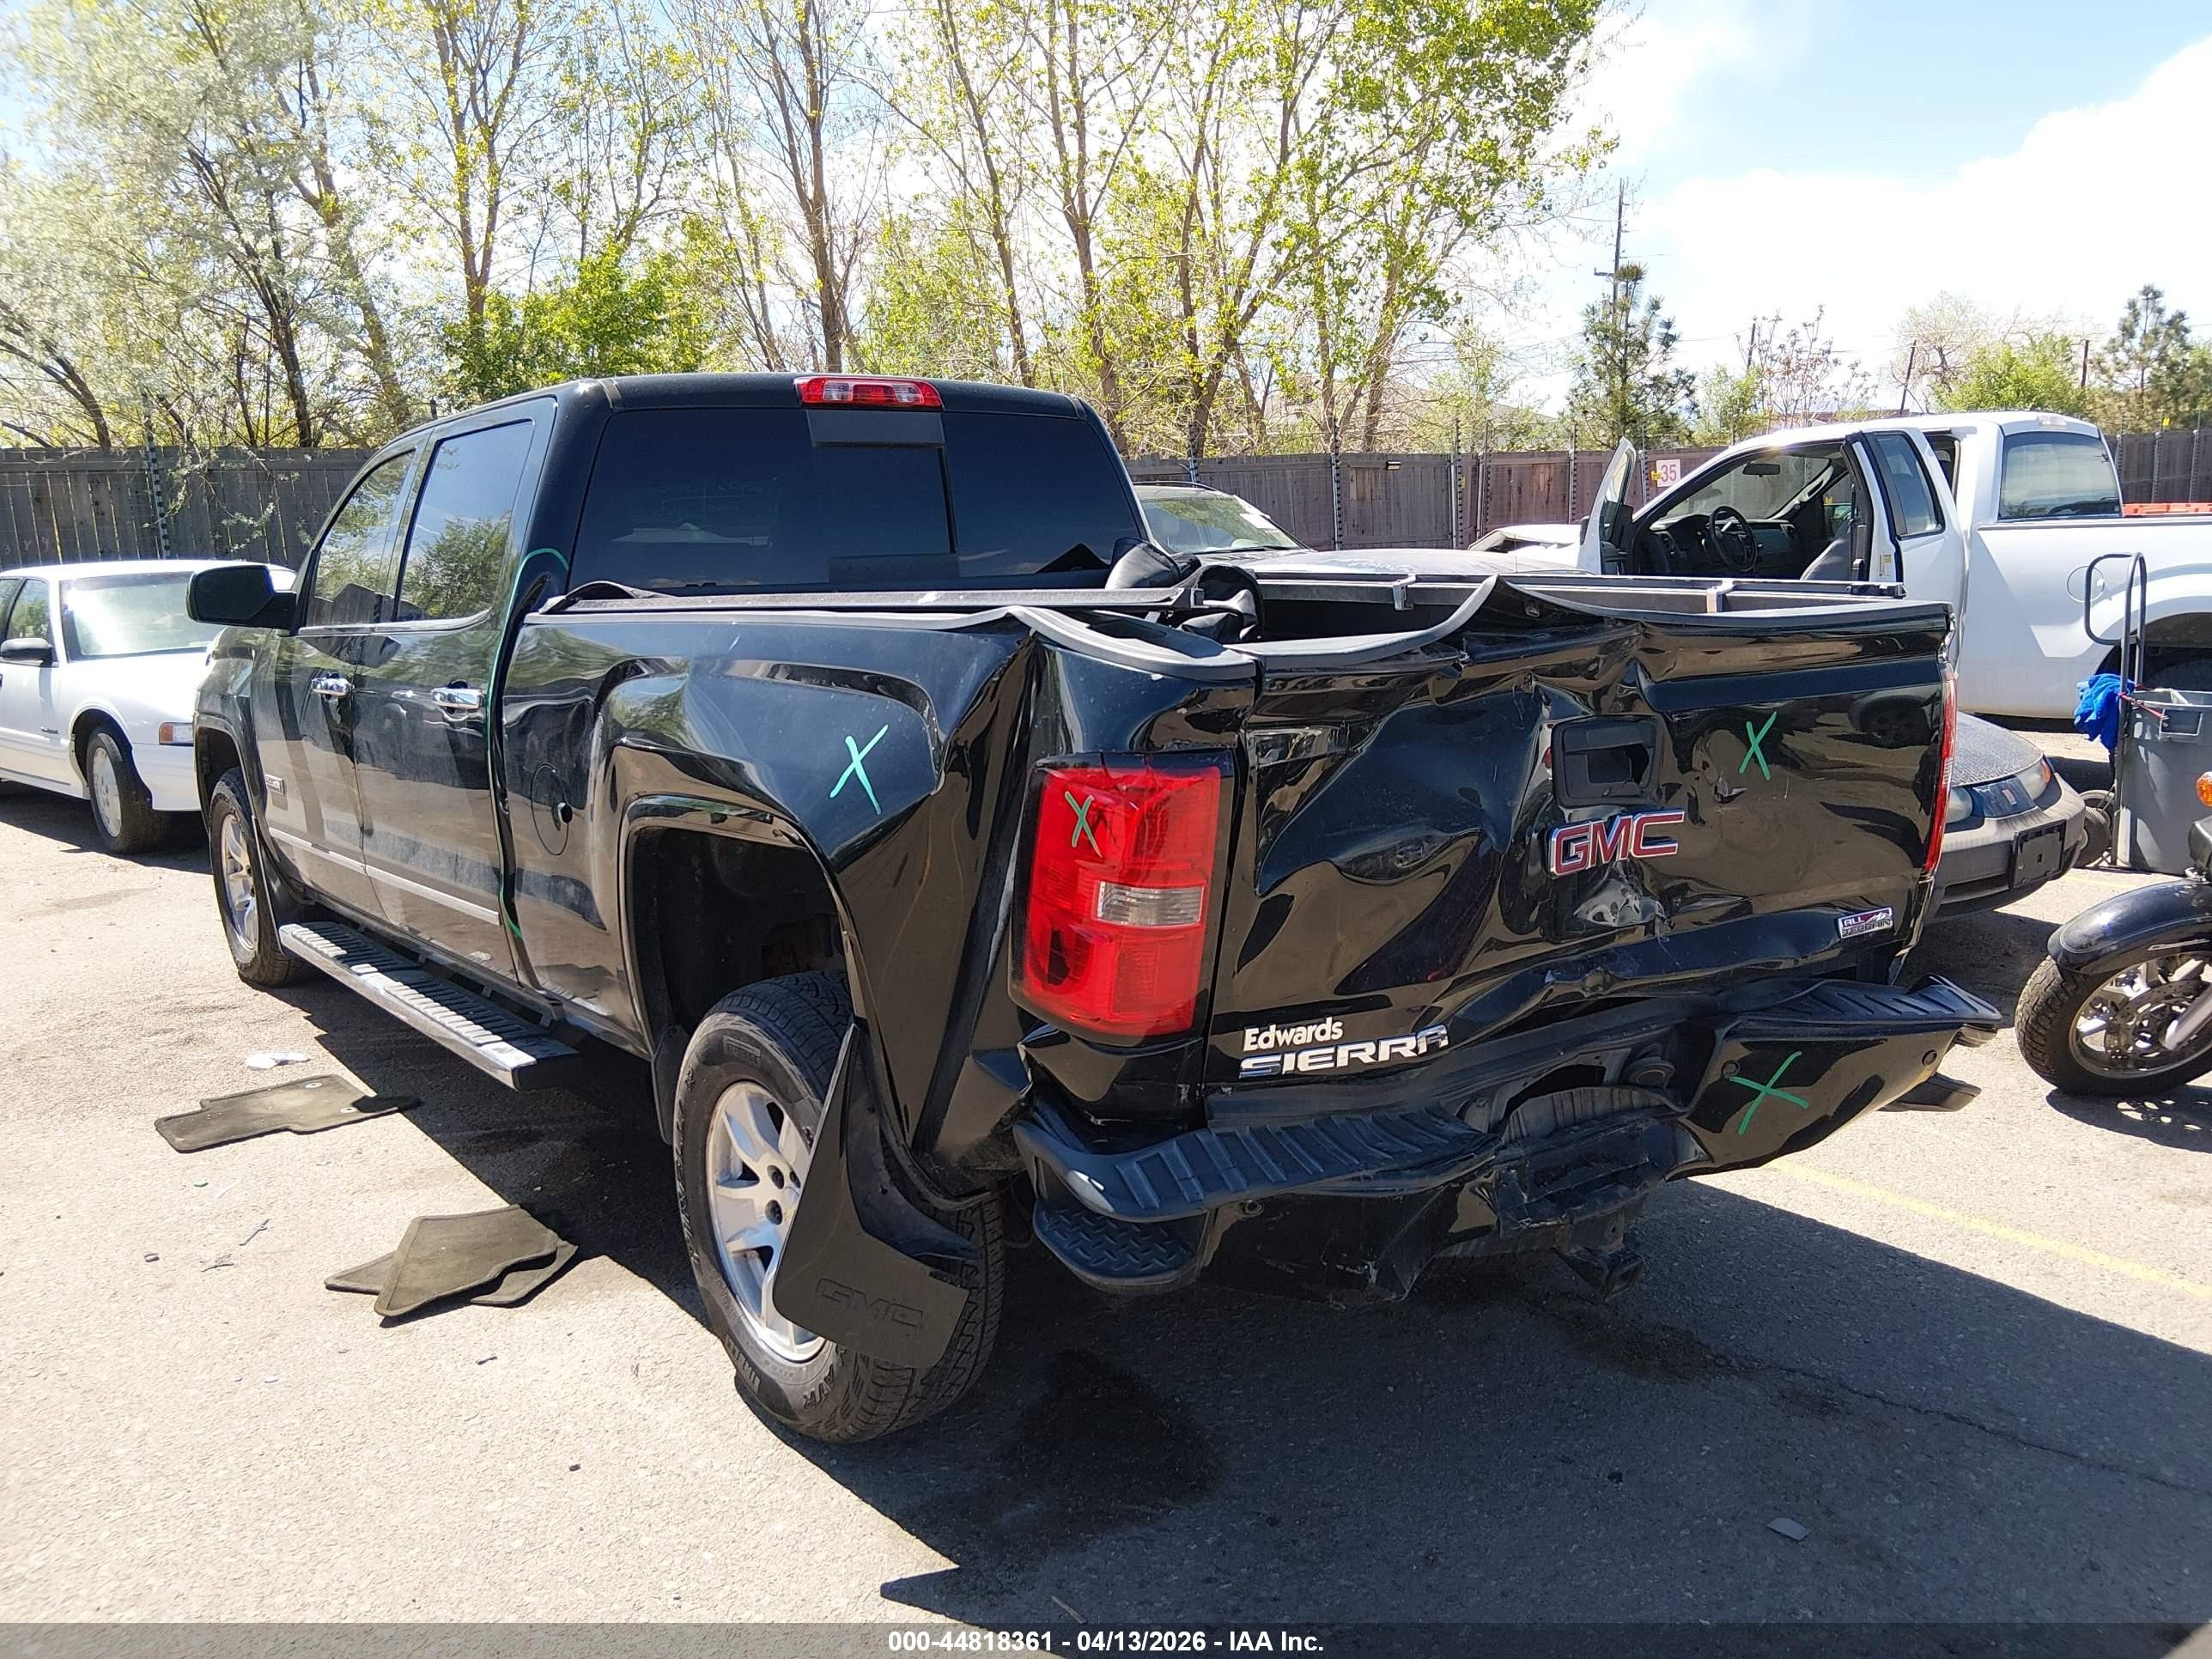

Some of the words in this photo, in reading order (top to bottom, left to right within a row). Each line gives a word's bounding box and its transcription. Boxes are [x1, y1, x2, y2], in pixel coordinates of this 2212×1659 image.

[1662, 464, 1677, 483] 35
[1550, 810, 1685, 877] GMC
[1844, 916, 1865, 927] ALL
[1238, 1024, 1449, 1079] SIERRA
[1243, 1017, 1344, 1052] Edwards
[816, 1278, 924, 1333] GMC
